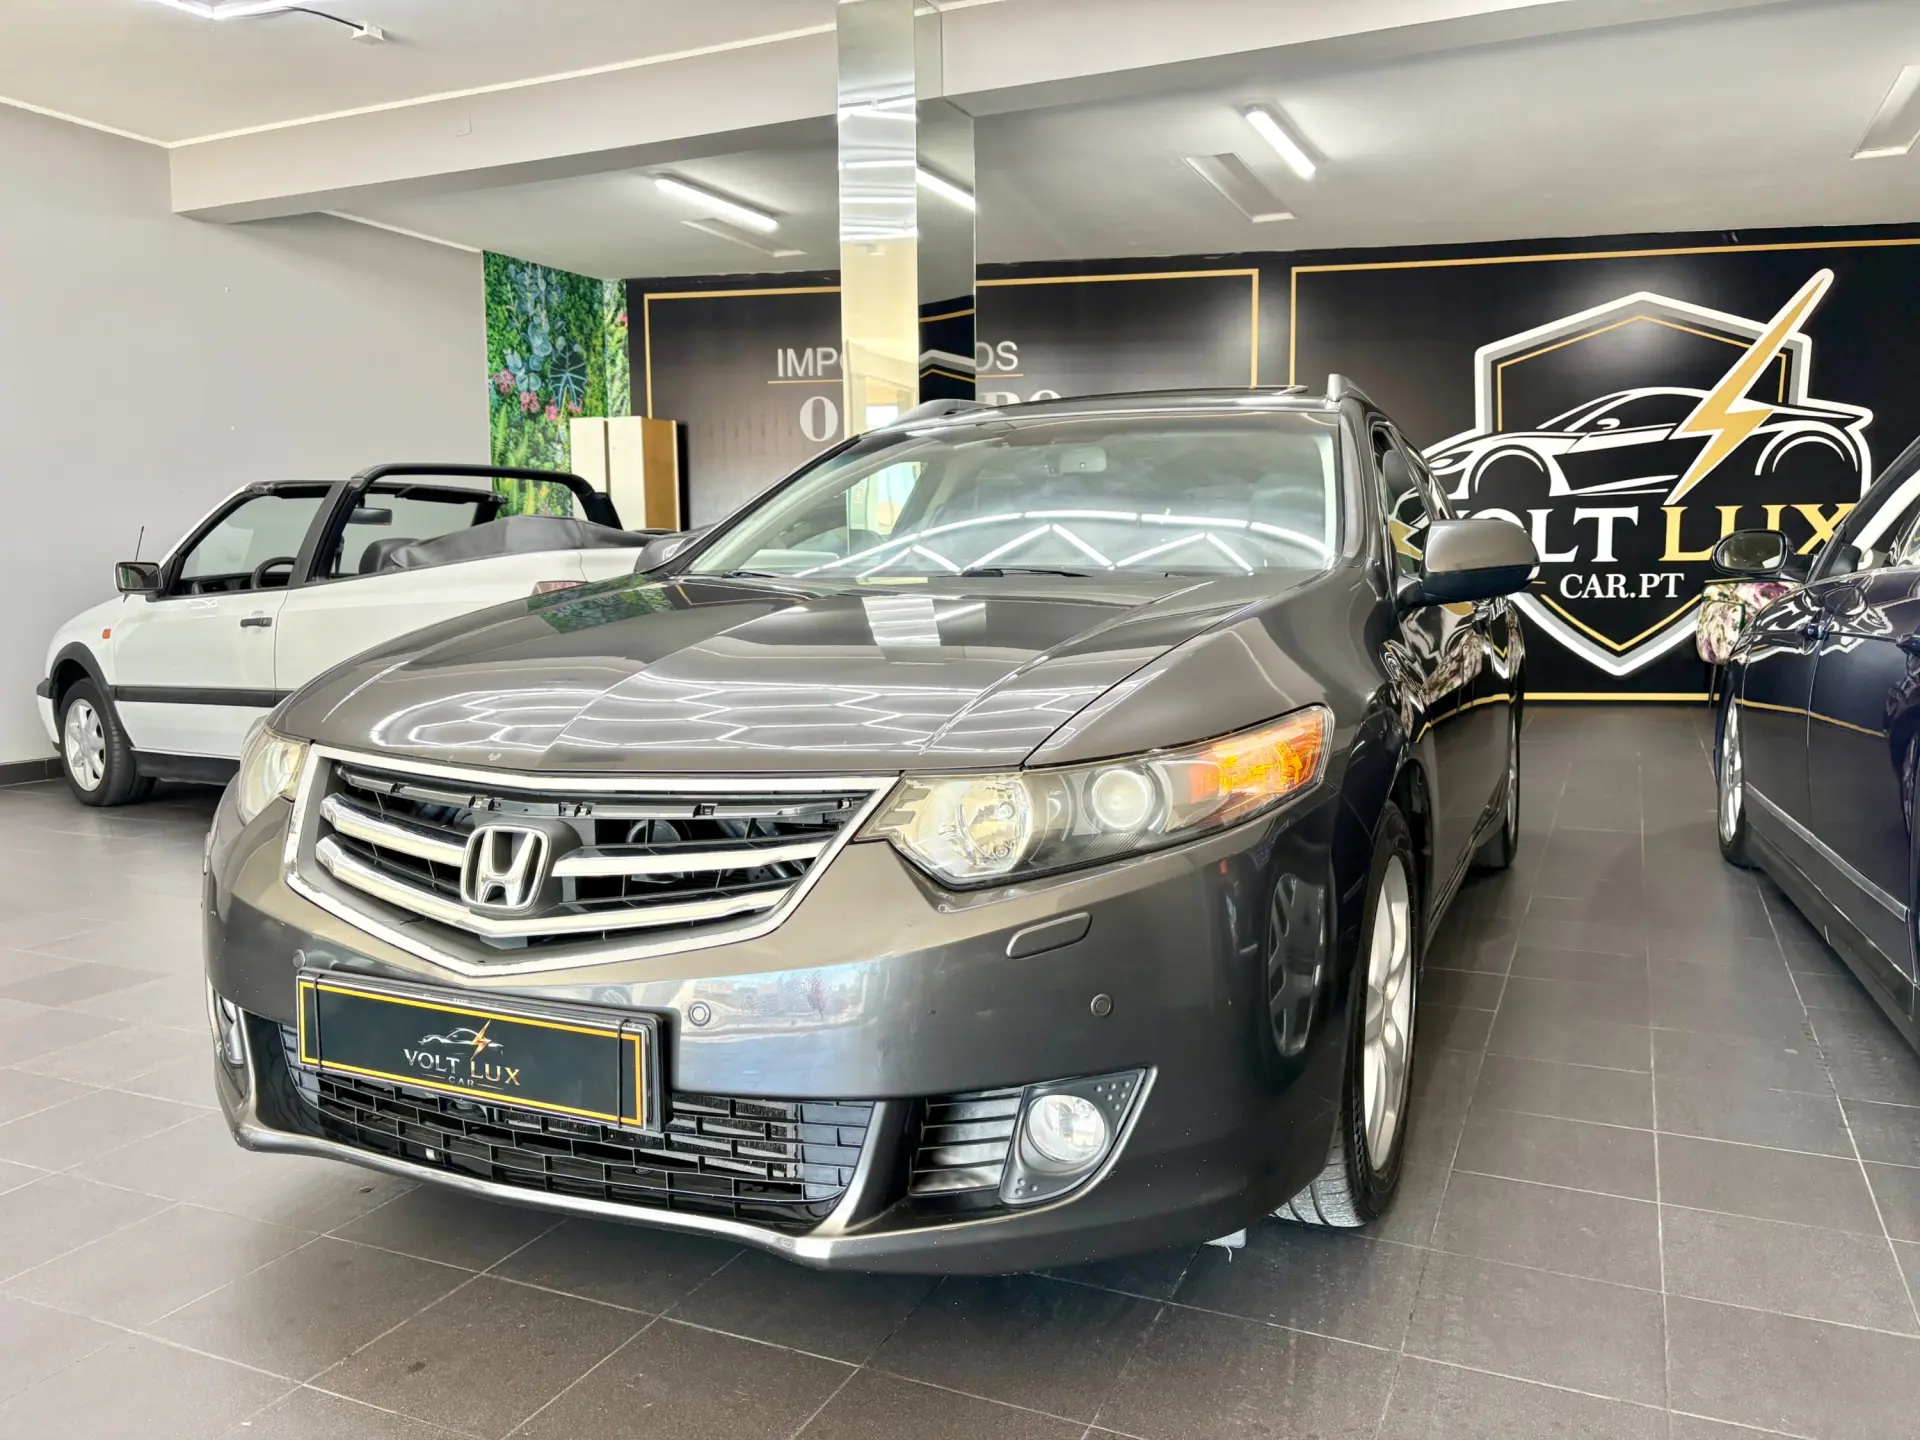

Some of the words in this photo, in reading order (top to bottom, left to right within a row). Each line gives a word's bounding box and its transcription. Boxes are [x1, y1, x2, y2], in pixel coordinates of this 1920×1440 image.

[1560, 573, 1685, 599] CAR.PT
[403, 1048, 460, 1075] VOLT
[470, 1060, 520, 1086] LUX
[448, 1075, 474, 1087] CAR
